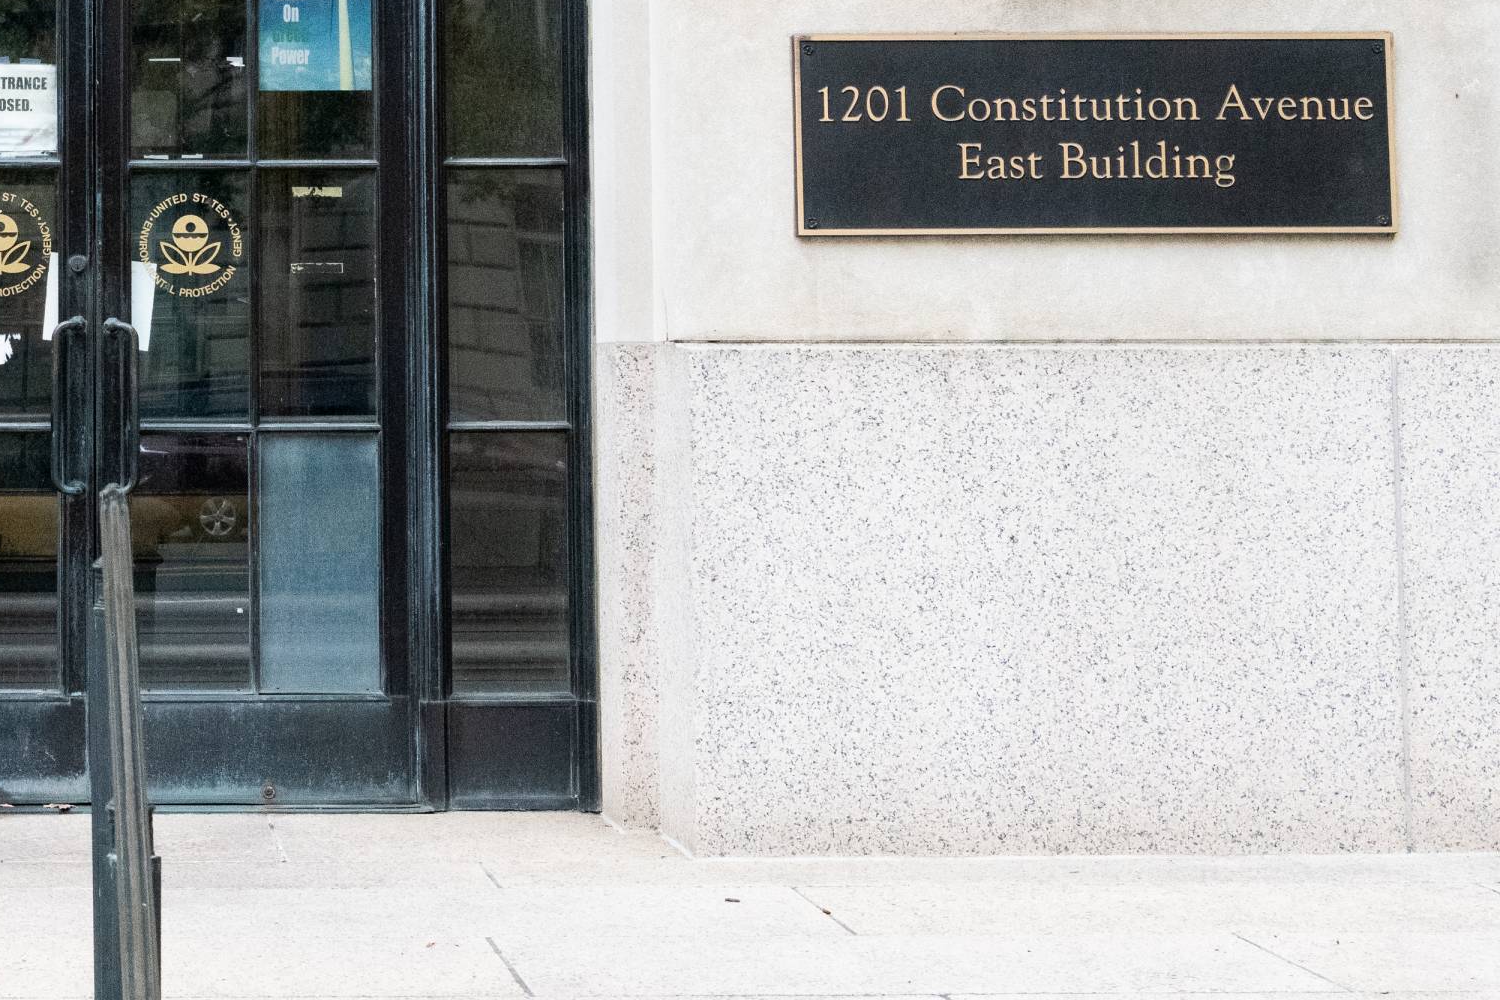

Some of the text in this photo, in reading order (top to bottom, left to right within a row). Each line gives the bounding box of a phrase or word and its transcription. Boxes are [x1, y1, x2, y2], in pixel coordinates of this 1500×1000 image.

[283, 4, 300, 23] On
[271, 47, 310, 65] Power
[817, 83, 1375, 123] 1201 Constitution Avenue
[957, 141, 1237, 188] East Building
[2, 192, 39, 218] STTES
[151, 193, 230, 219] UNITED STTES
[178, 265, 237, 298] PROTECTION
[228, 222, 242, 258] GENCY
